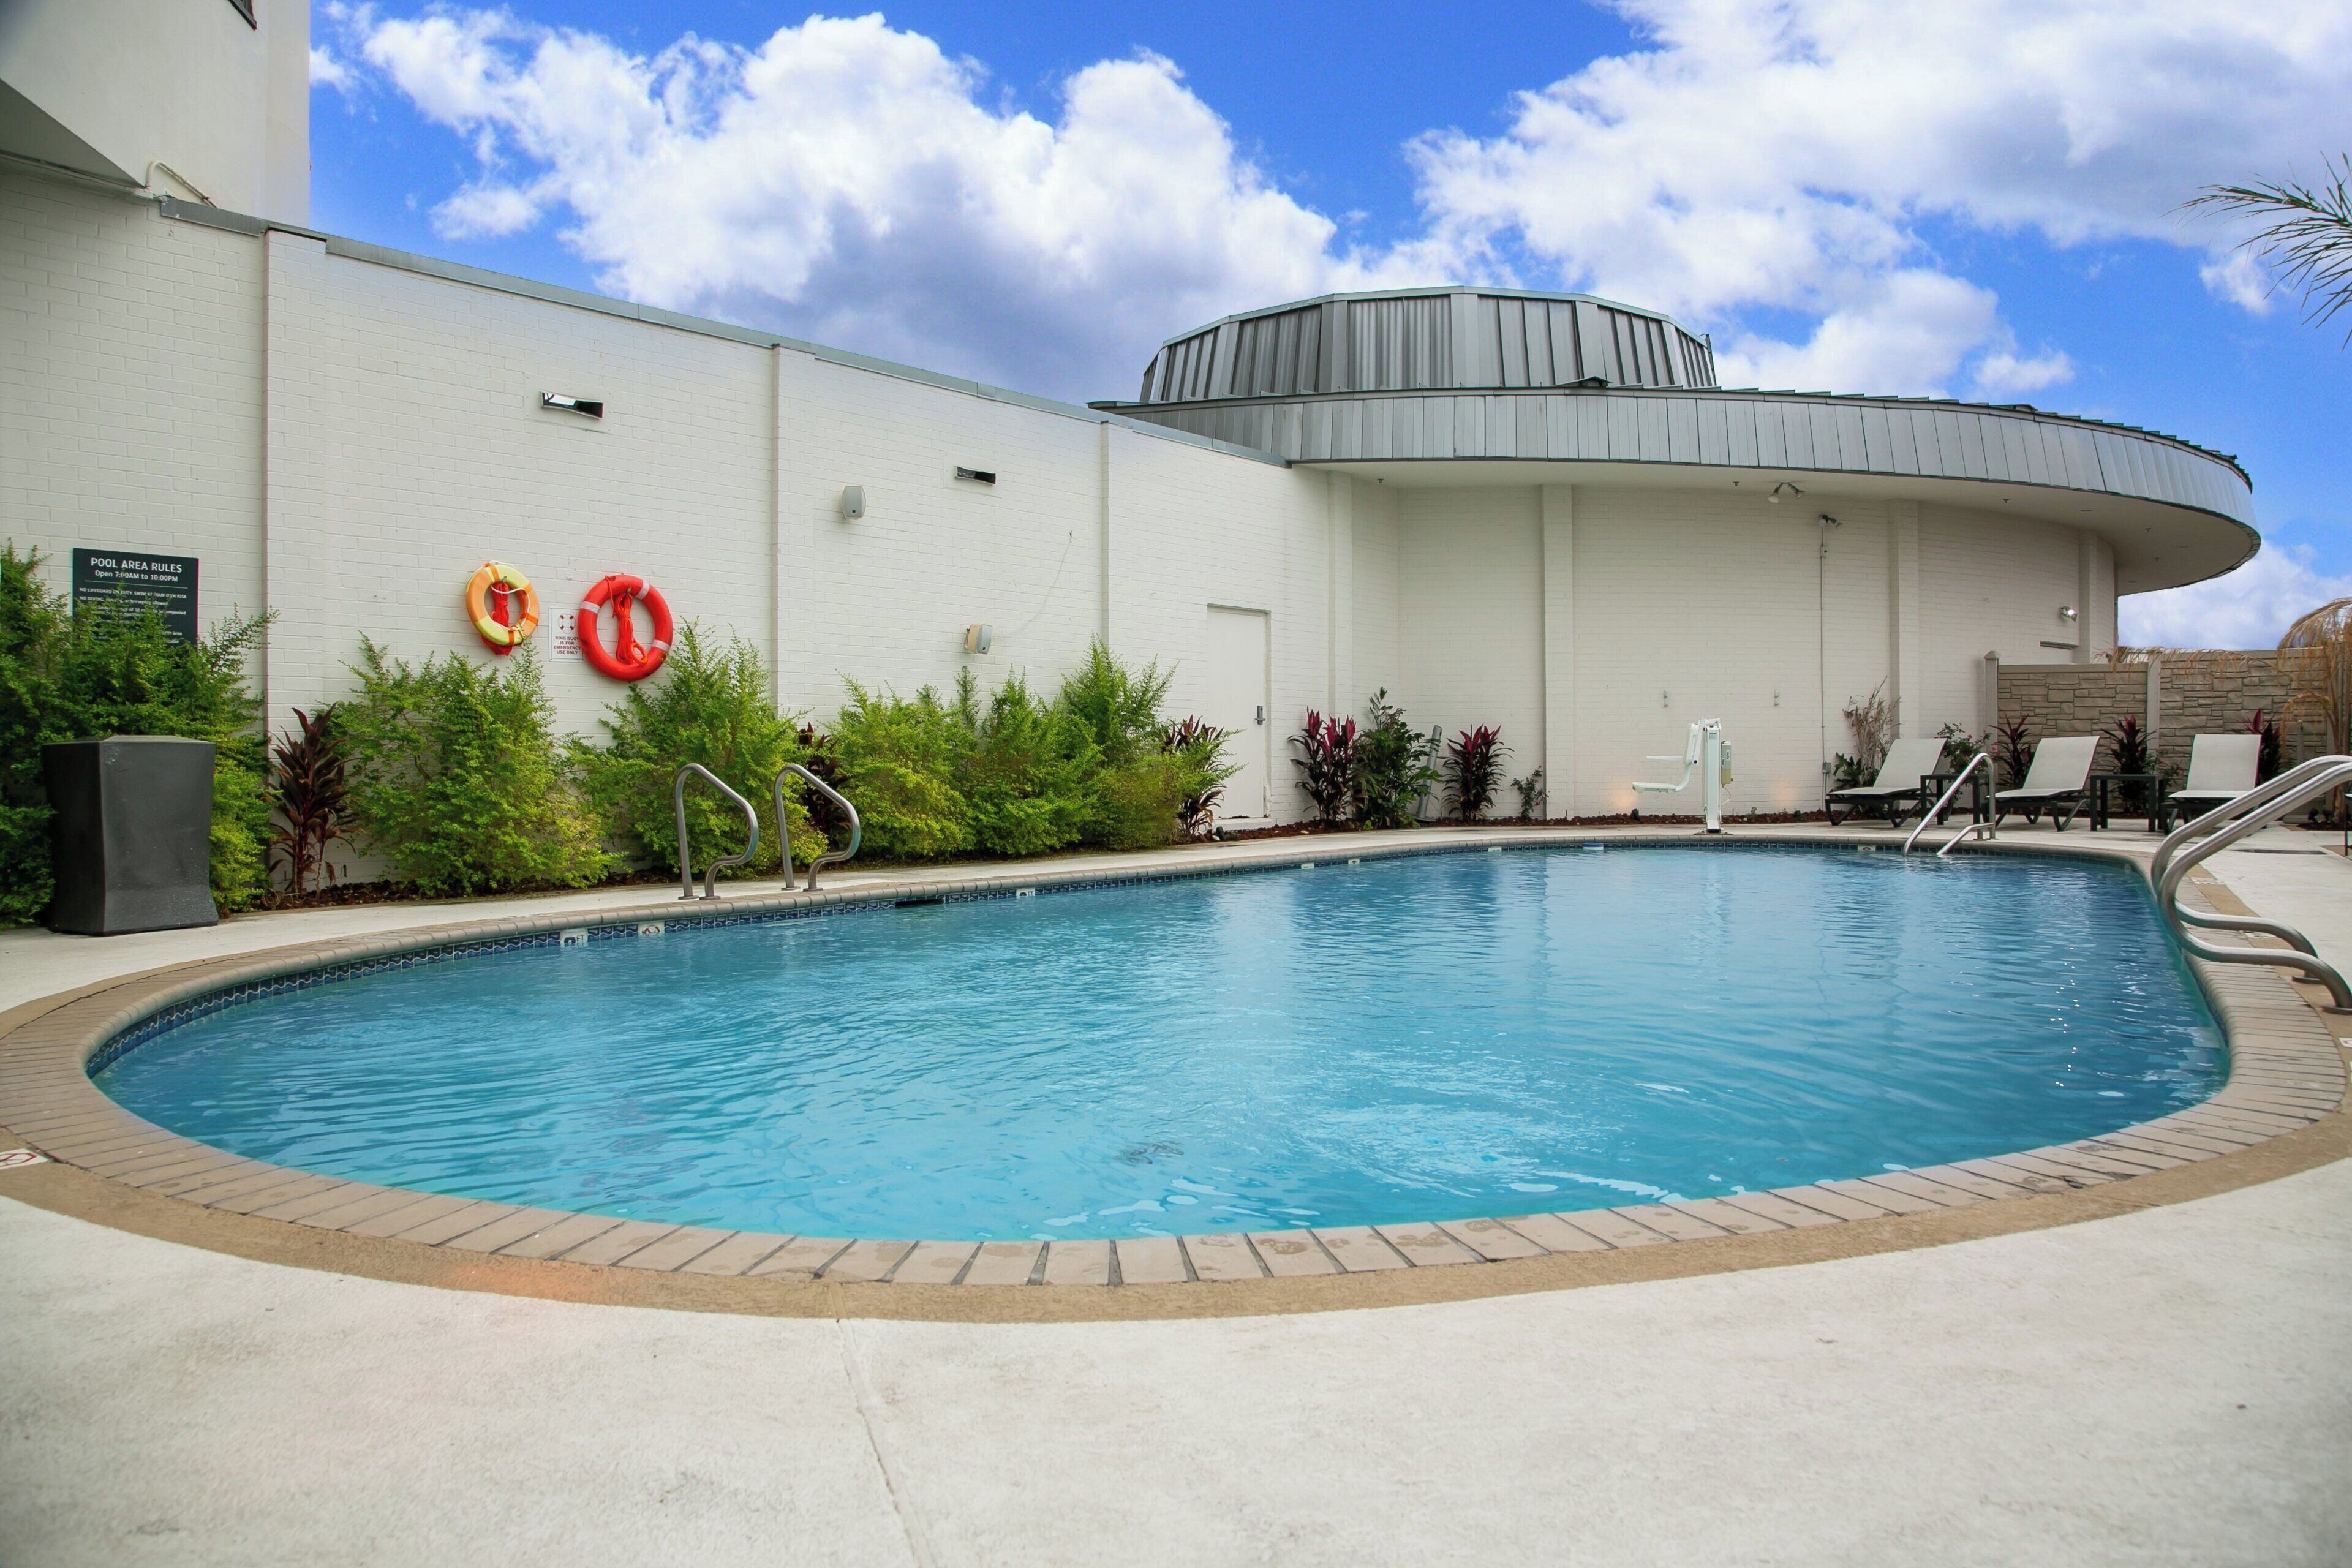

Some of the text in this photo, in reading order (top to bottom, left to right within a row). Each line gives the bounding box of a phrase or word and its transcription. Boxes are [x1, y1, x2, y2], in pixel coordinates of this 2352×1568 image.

[91, 557, 183, 573] POOL AREA RULES
